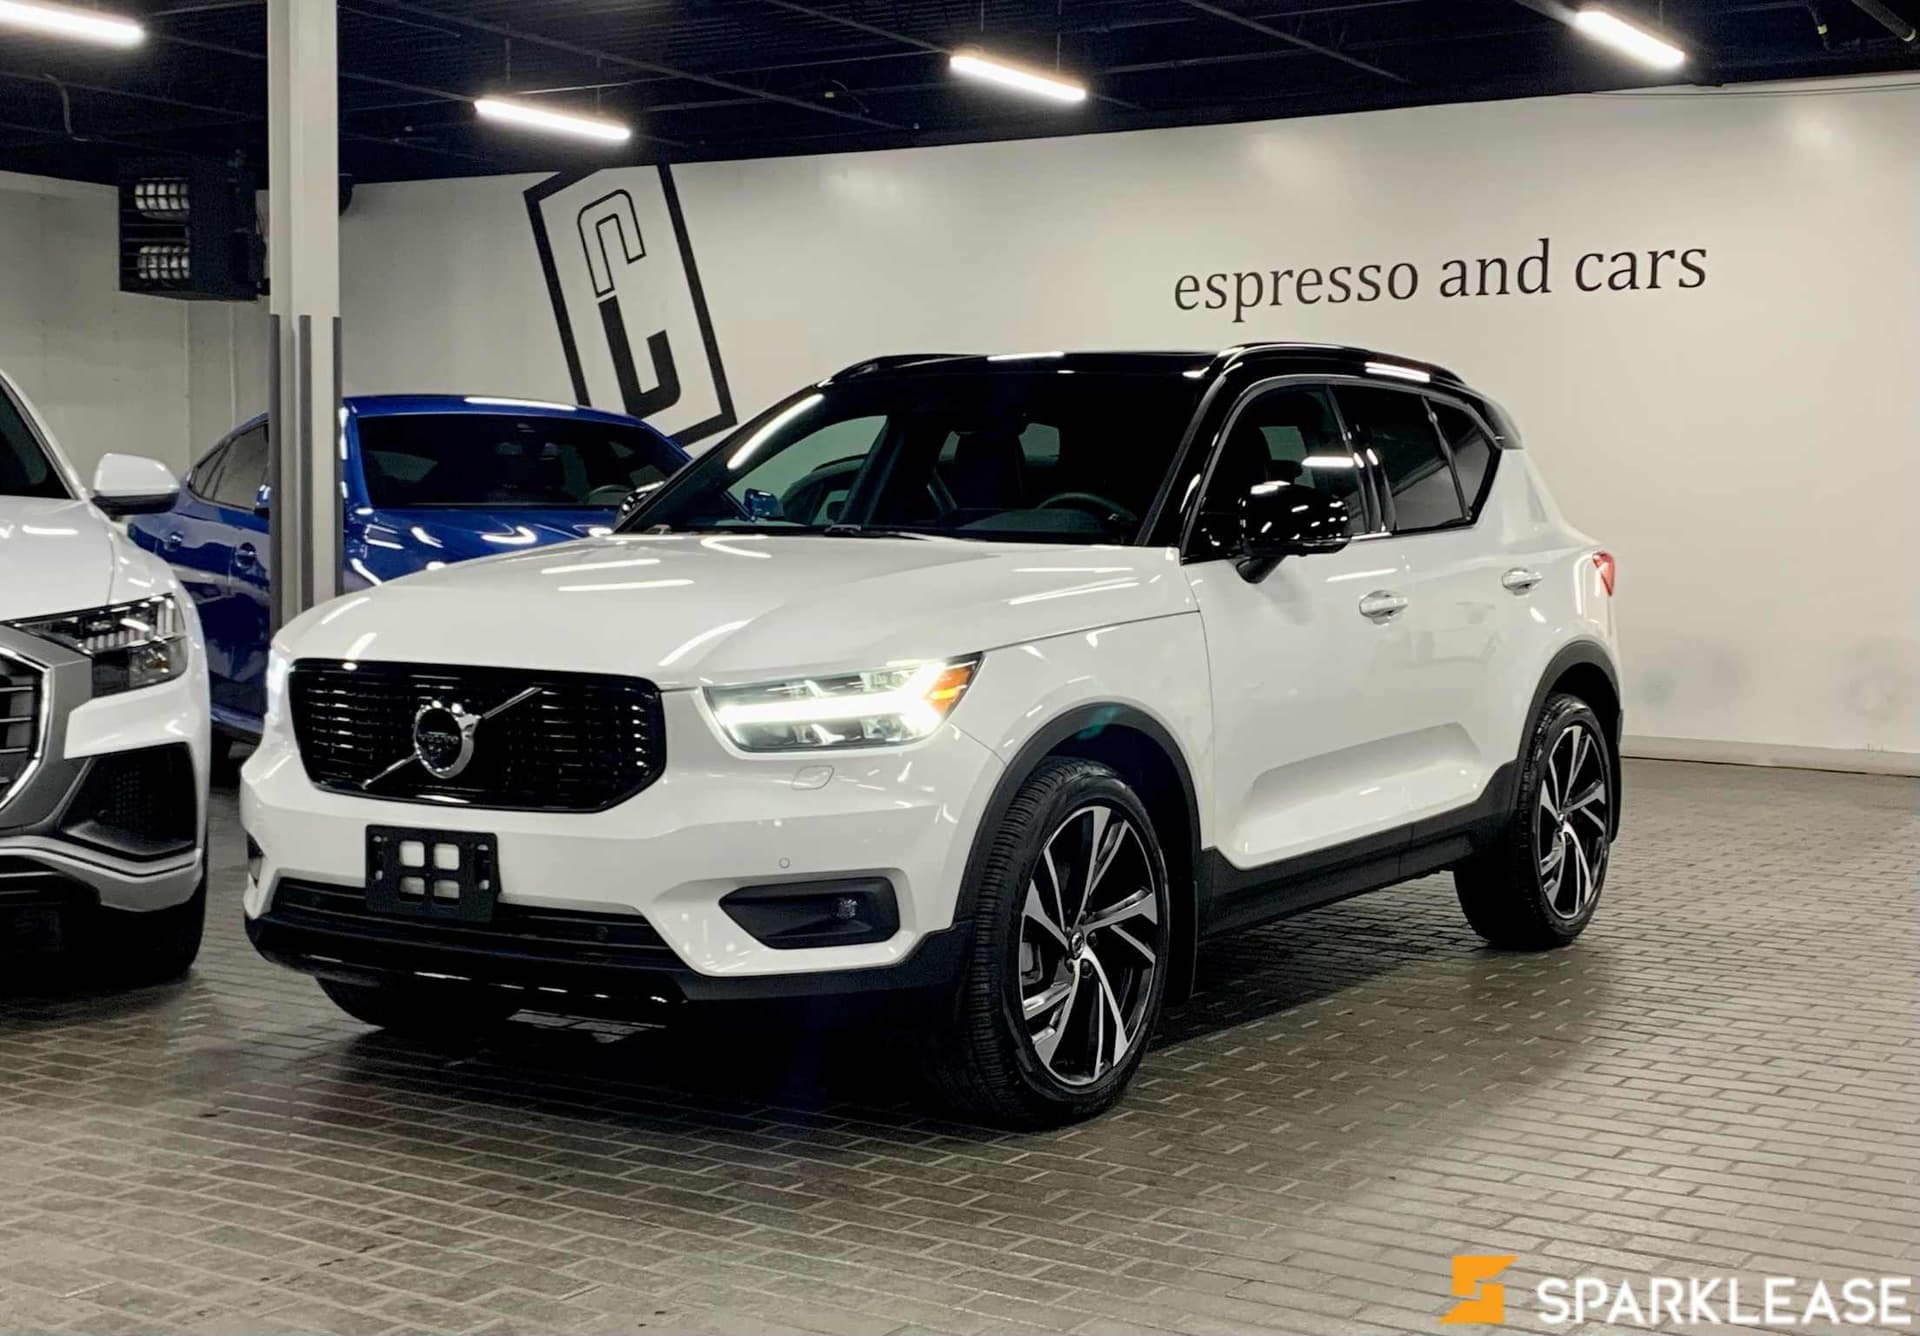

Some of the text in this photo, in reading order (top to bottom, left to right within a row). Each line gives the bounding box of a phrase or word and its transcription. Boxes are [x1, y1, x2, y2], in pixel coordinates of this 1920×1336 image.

[1174, 237, 1707, 323] espresso and cars
